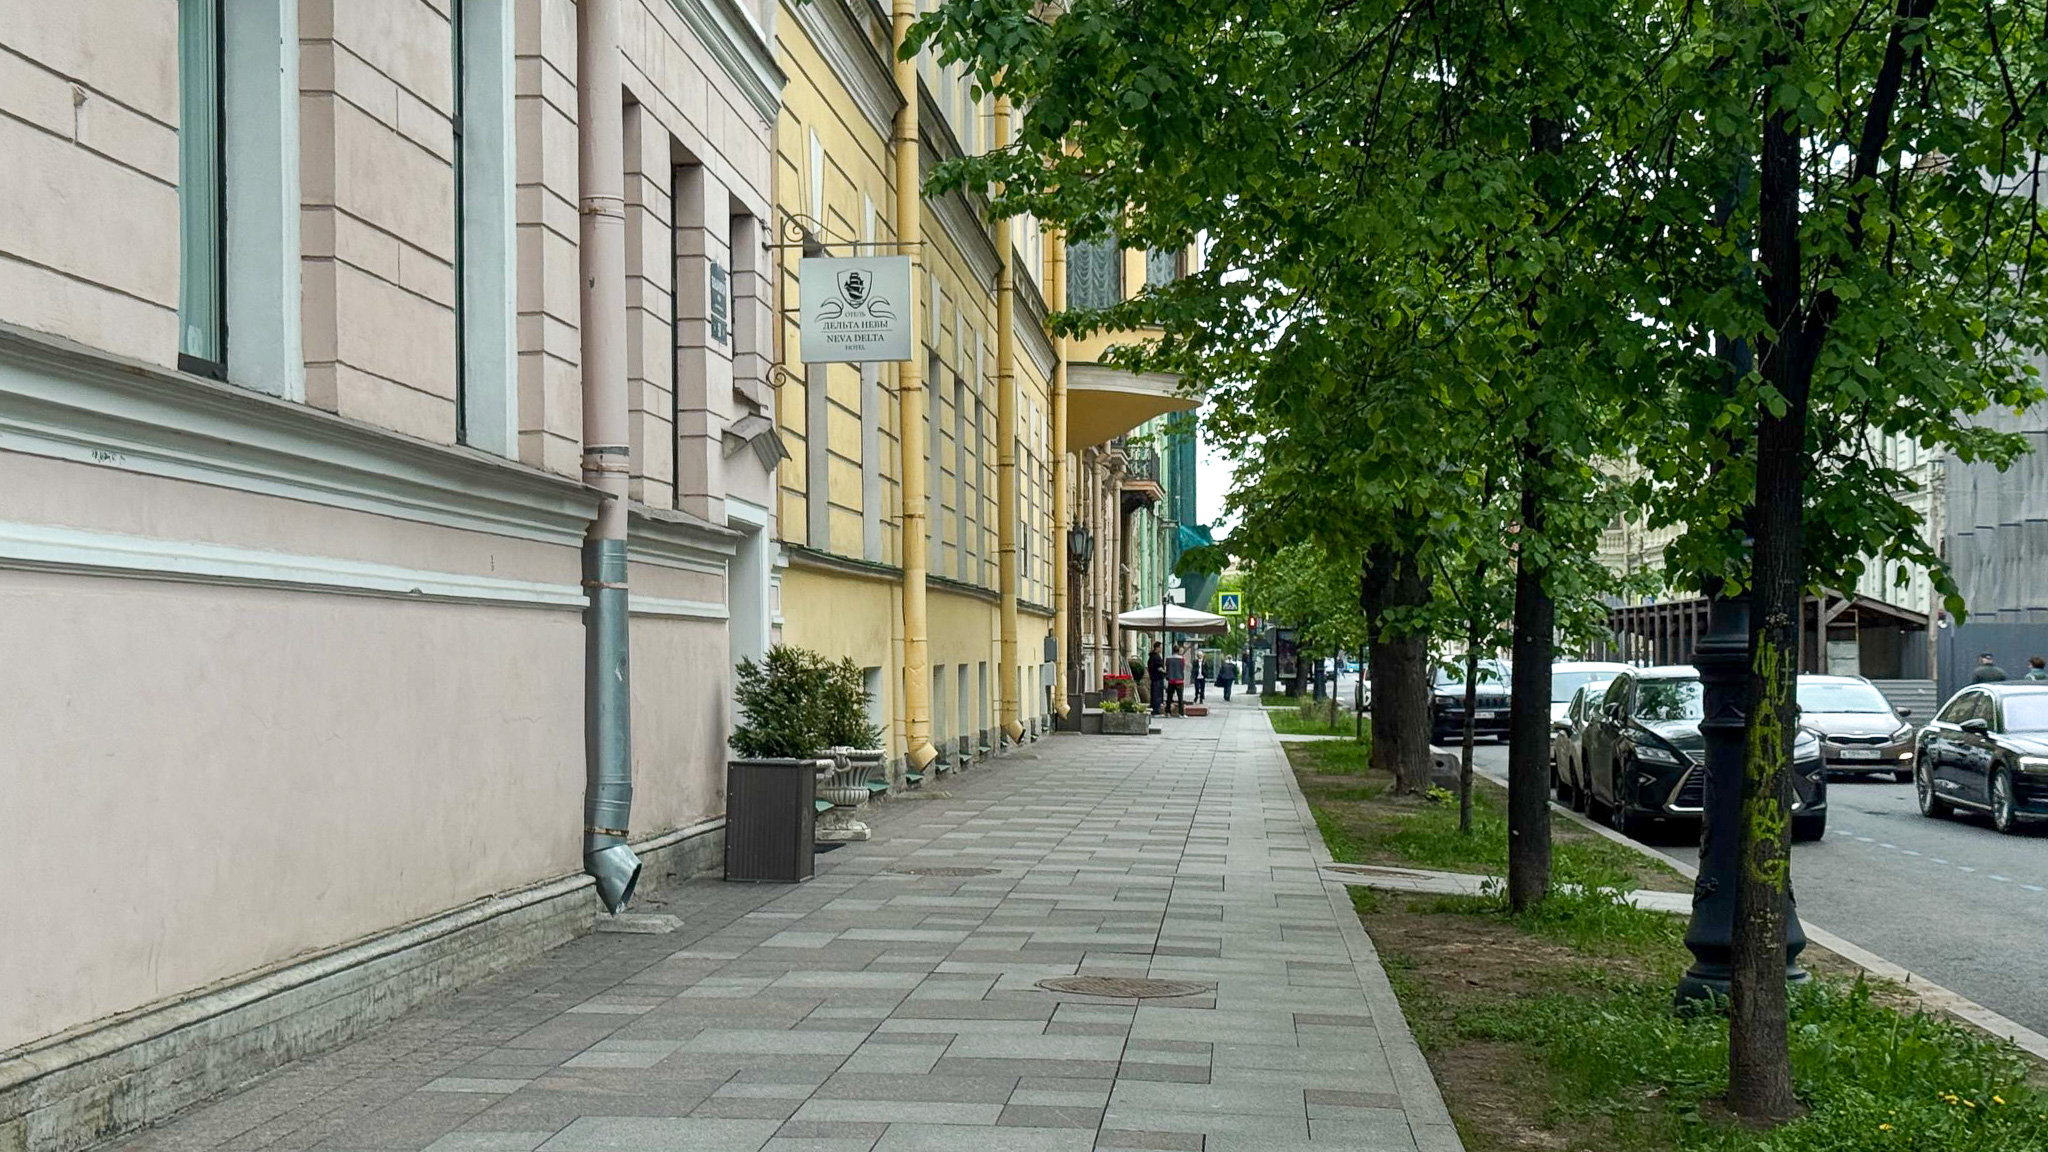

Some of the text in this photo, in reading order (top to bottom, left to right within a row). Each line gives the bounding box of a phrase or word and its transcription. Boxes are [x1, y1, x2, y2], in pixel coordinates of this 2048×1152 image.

[823, 320, 889, 330] ДЕЛЬТА НЕВЫ
[826, 333, 885, 343] NEVA DELTA
